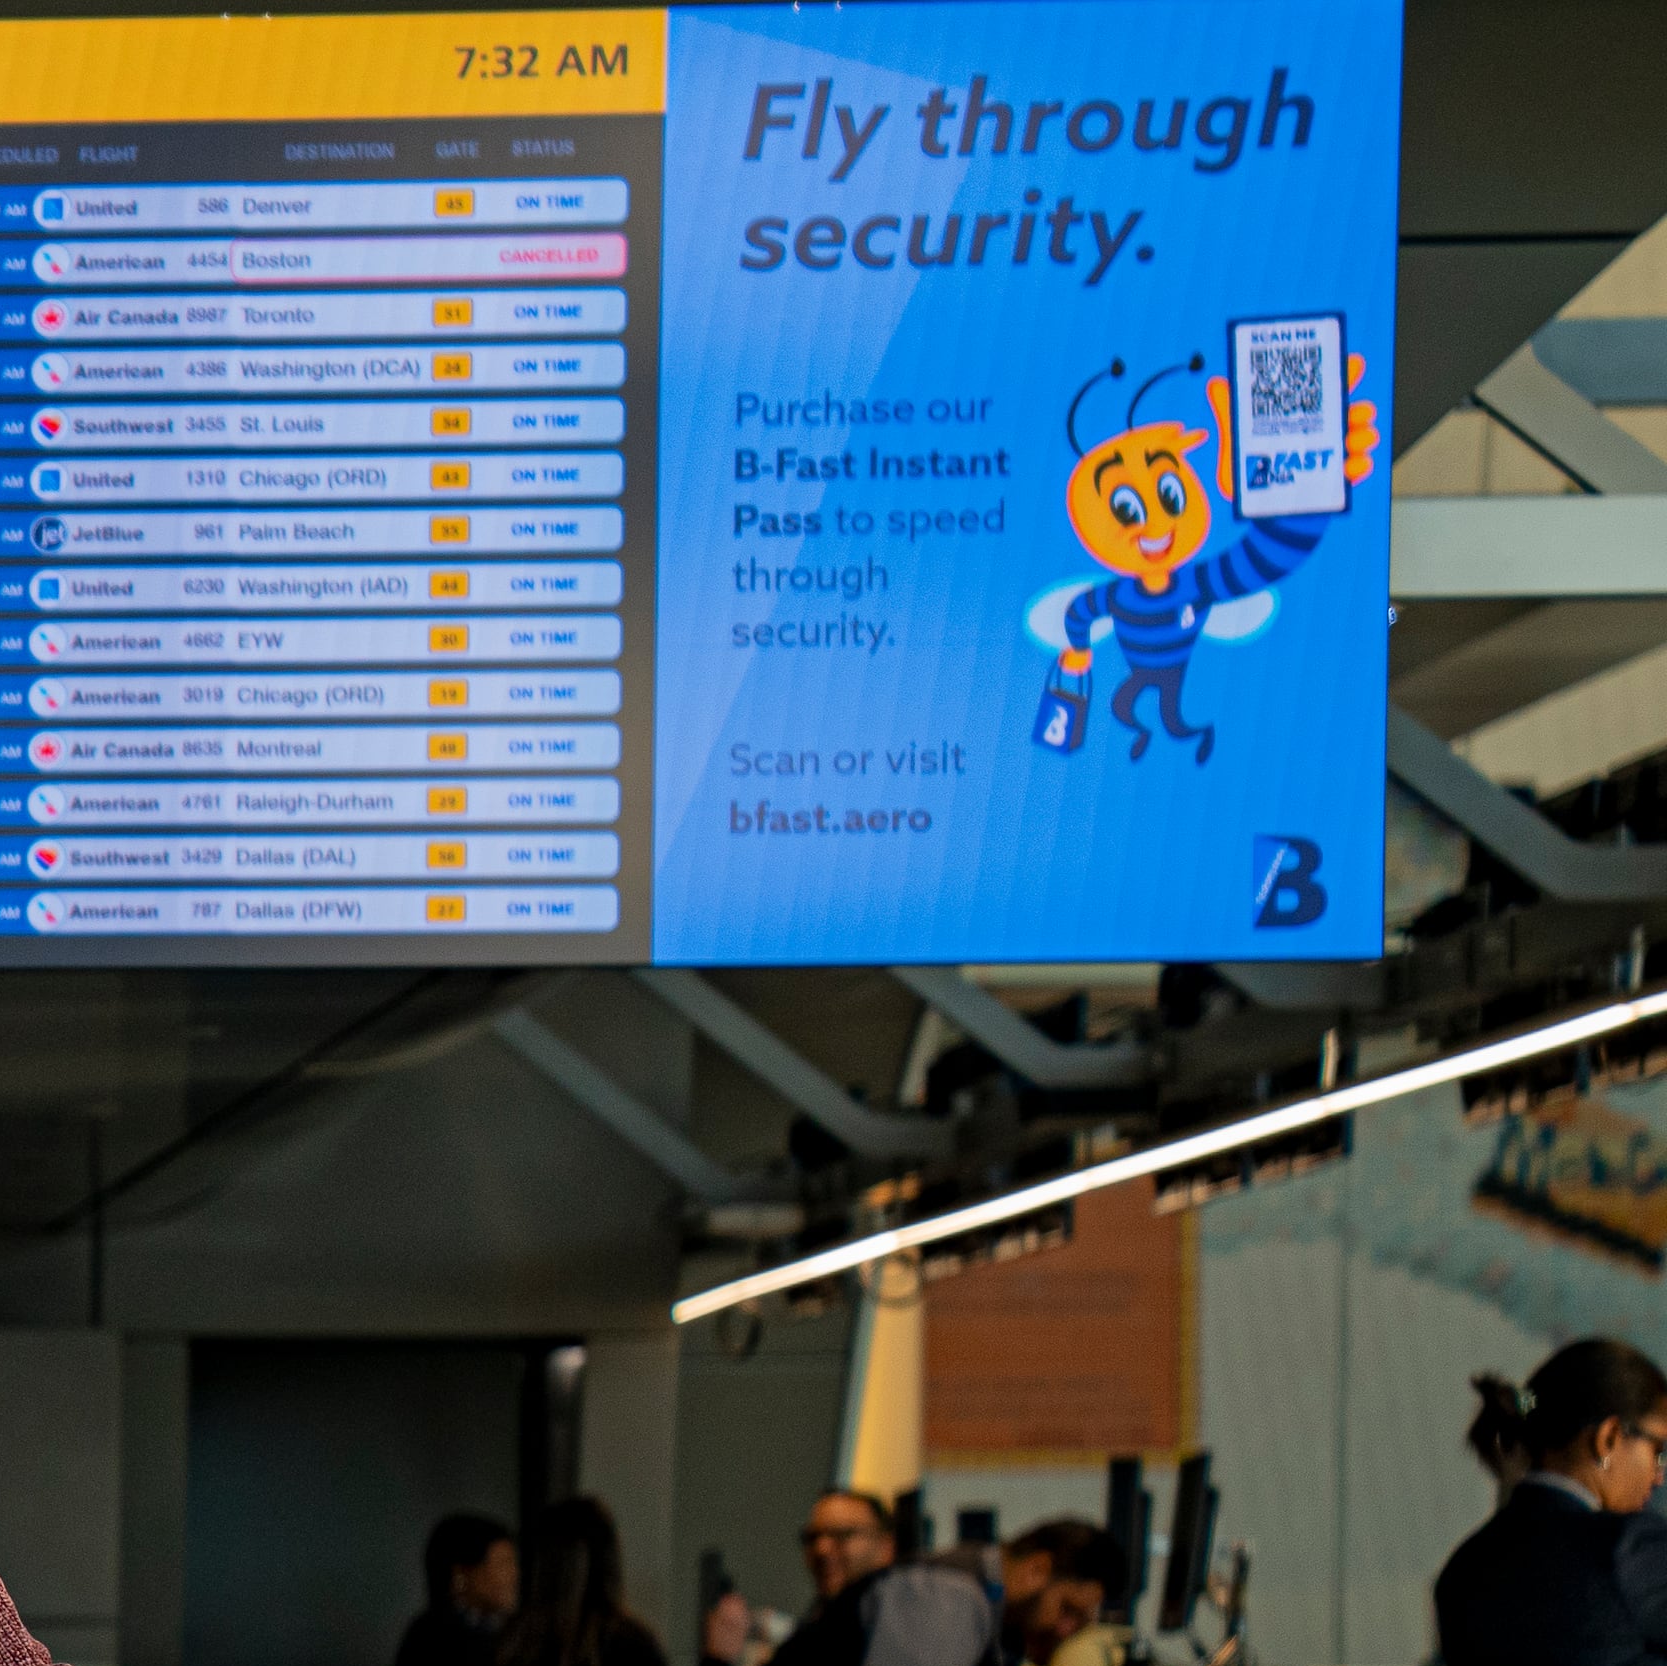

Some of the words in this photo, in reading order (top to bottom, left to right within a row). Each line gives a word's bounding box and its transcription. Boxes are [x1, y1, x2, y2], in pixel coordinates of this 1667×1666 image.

[455, 46, 538, 80] 7:32
[555, 44, 629, 77] AM
[743, 78, 889, 182] Fly
[918, 68, 1315, 174] through
[75, 200, 137, 217] United
[243, 198, 311, 215] Denver
[741, 188, 1155, 287] security.
[243, 252, 311, 269] Boston
[500, 248, 599, 264] CANCELLED
[243, 307, 315, 324] Toronto
[241, 360, 355, 382] Washington
[735, 392, 915, 430] Purchase
[927, 398, 993, 424] our
[734, 450, 855, 482] B-Fast
[870, 449, 1009, 480] Instant
[239, 524, 287, 541] Palm
[295, 523, 354, 540] Beach
[733, 505, 823, 537] Pass
[835, 508, 874, 536] to
[887, 499, 1005, 544] speed
[733, 558, 889, 600] through
[238, 632, 283, 649] EYW
[730, 616, 896, 657] security.
[237, 741, 321, 757] Montreal
[730, 744, 820, 777] Scan
[833, 749, 873, 776] or
[886, 742, 966, 775] visit
[237, 794, 393, 814] Raleigh-Durham
[729, 802, 933, 836] bfast.aero
